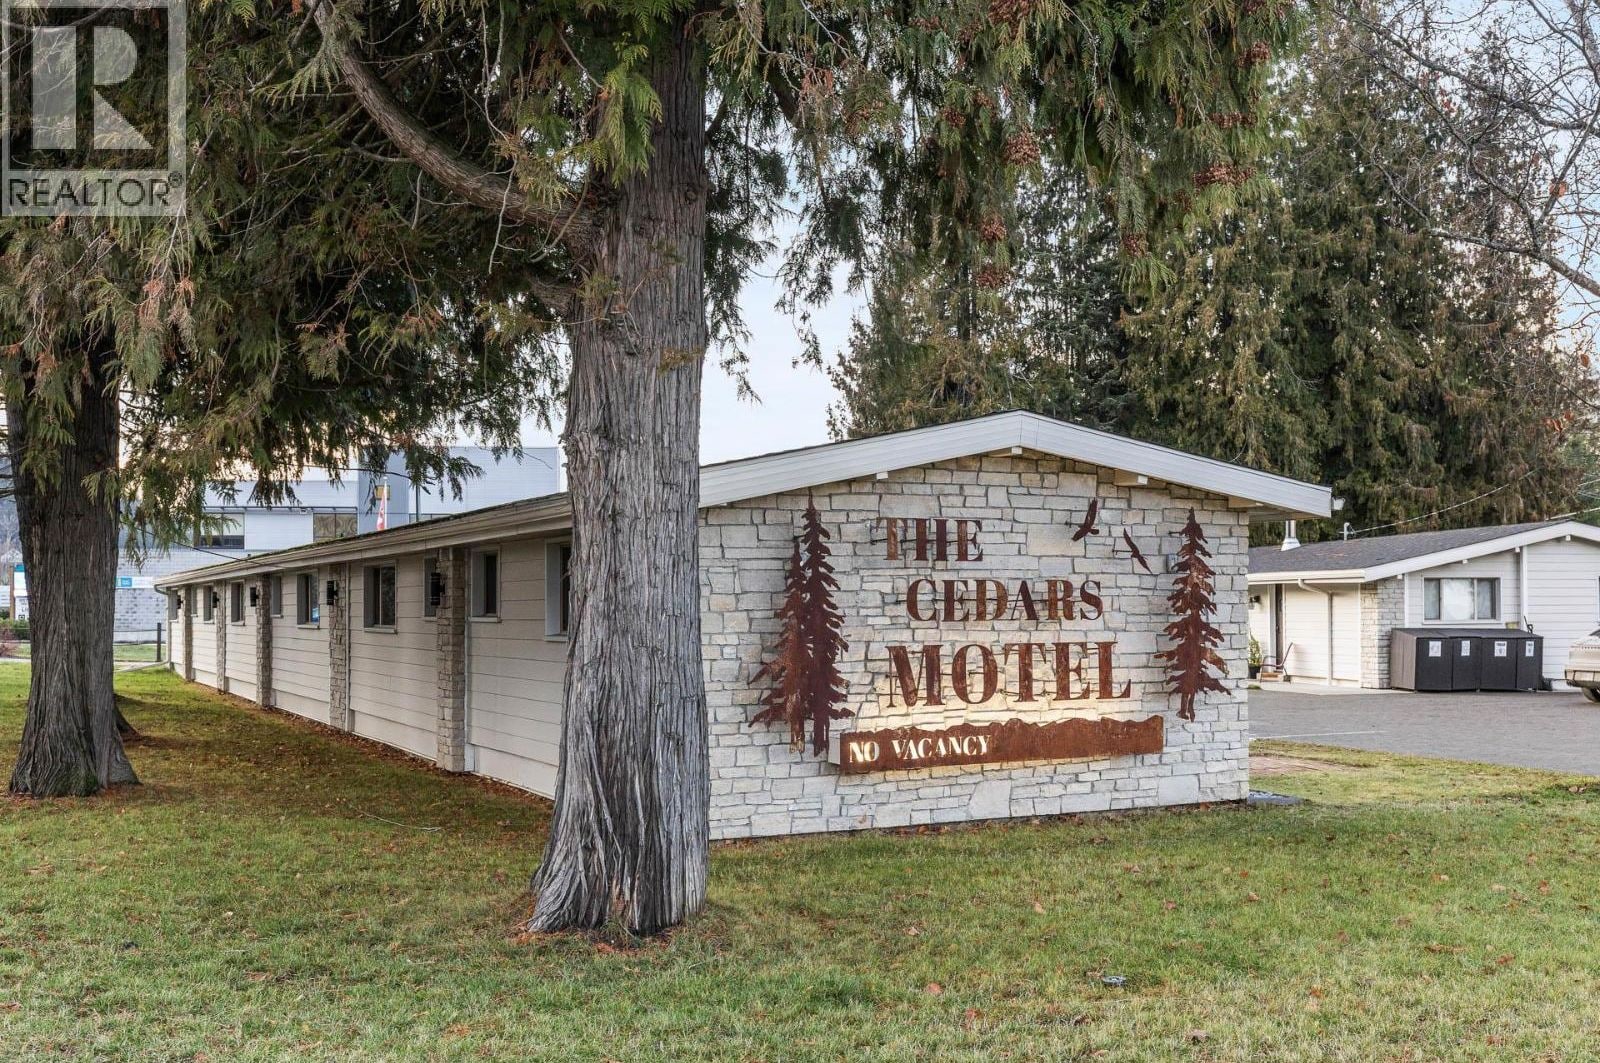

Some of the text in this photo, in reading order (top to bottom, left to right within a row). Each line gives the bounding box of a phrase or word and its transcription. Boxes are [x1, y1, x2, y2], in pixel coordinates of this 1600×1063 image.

[876, 519, 983, 562] THE
[906, 579, 1103, 621] CEDARS
[886, 641, 1131, 707] MOTEL
[849, 735, 991, 763] NO VACANCY
